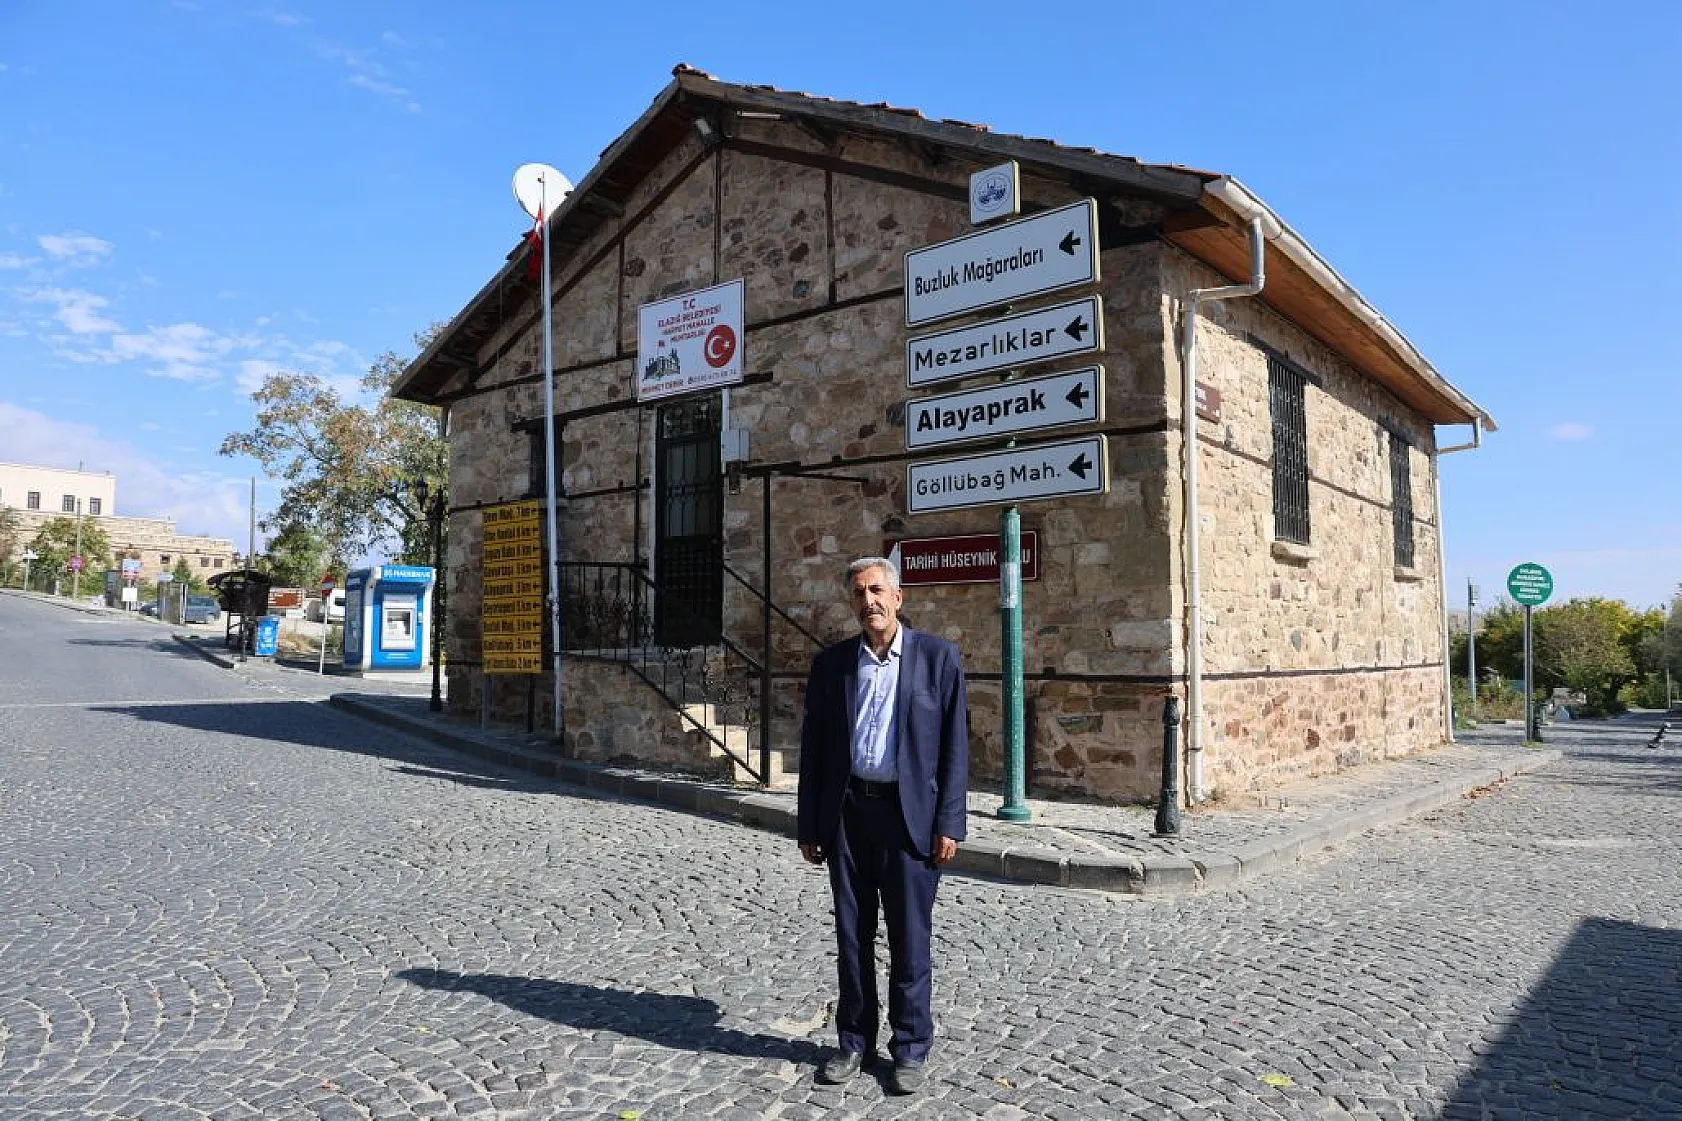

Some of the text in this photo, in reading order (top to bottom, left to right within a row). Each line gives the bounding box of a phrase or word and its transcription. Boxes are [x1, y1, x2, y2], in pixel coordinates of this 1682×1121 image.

[914, 247, 1044, 297] Buzluk Mağaraları
[914, 328, 1056, 371] Mezarlıklar
[916, 388, 1047, 432] Alayaprak
[916, 461, 1061, 496] Göllübağ Mah.
[904, 551, 939, 571] TARİHİ
[940, 548, 998, 569] HÜSEYNİK
